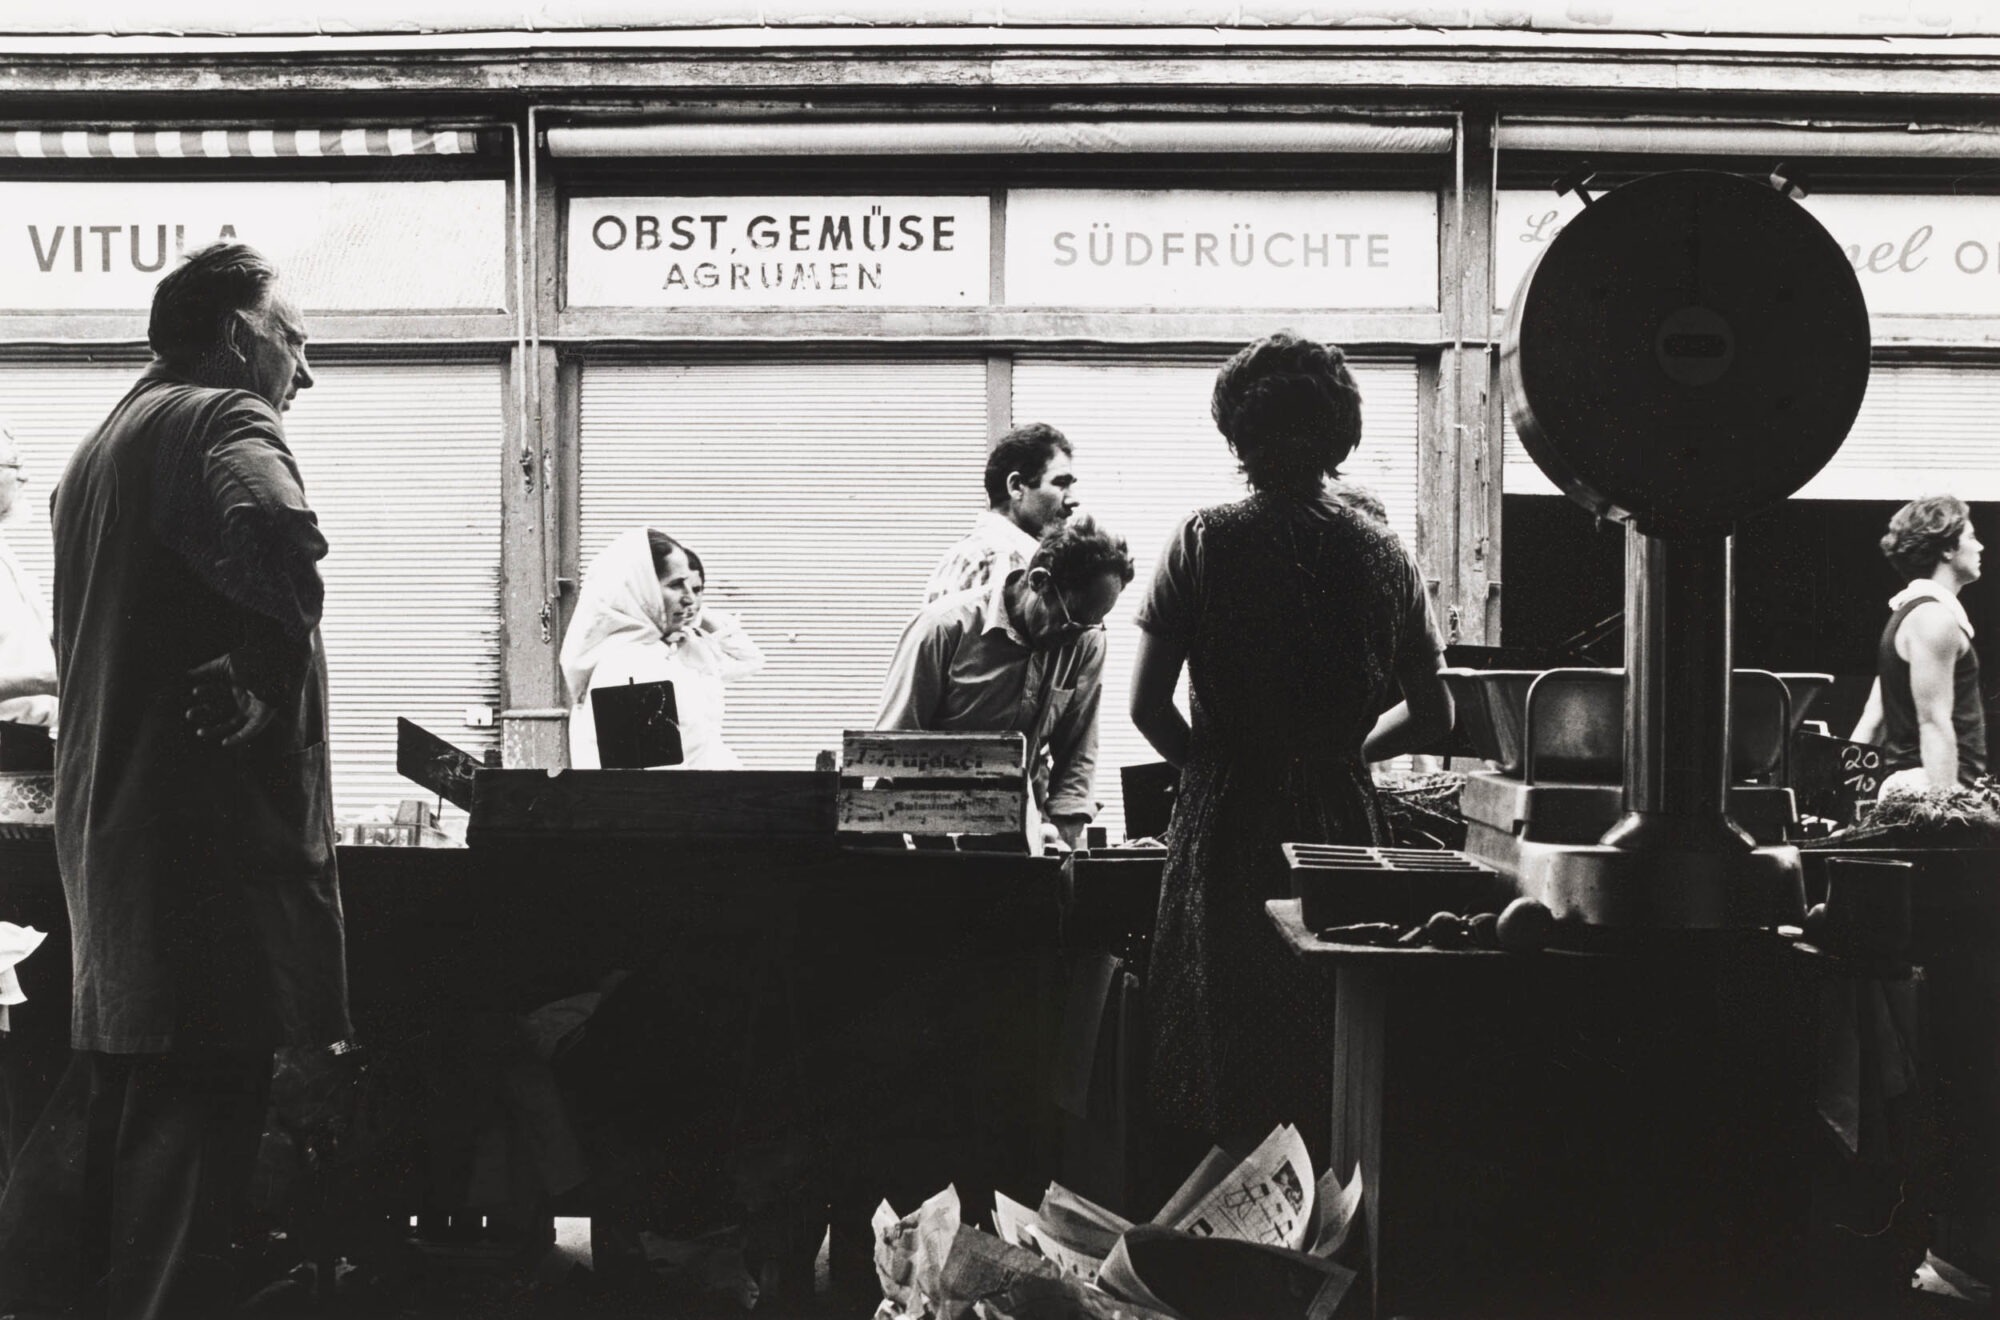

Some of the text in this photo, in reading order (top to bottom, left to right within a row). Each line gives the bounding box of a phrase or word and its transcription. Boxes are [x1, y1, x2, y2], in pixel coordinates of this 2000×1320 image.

[1053, 222, 1390, 267] SÜDFRÜCHTE
[662, 261, 882, 291] AGRUMEN
[1841, 745, 1880, 770] 20
